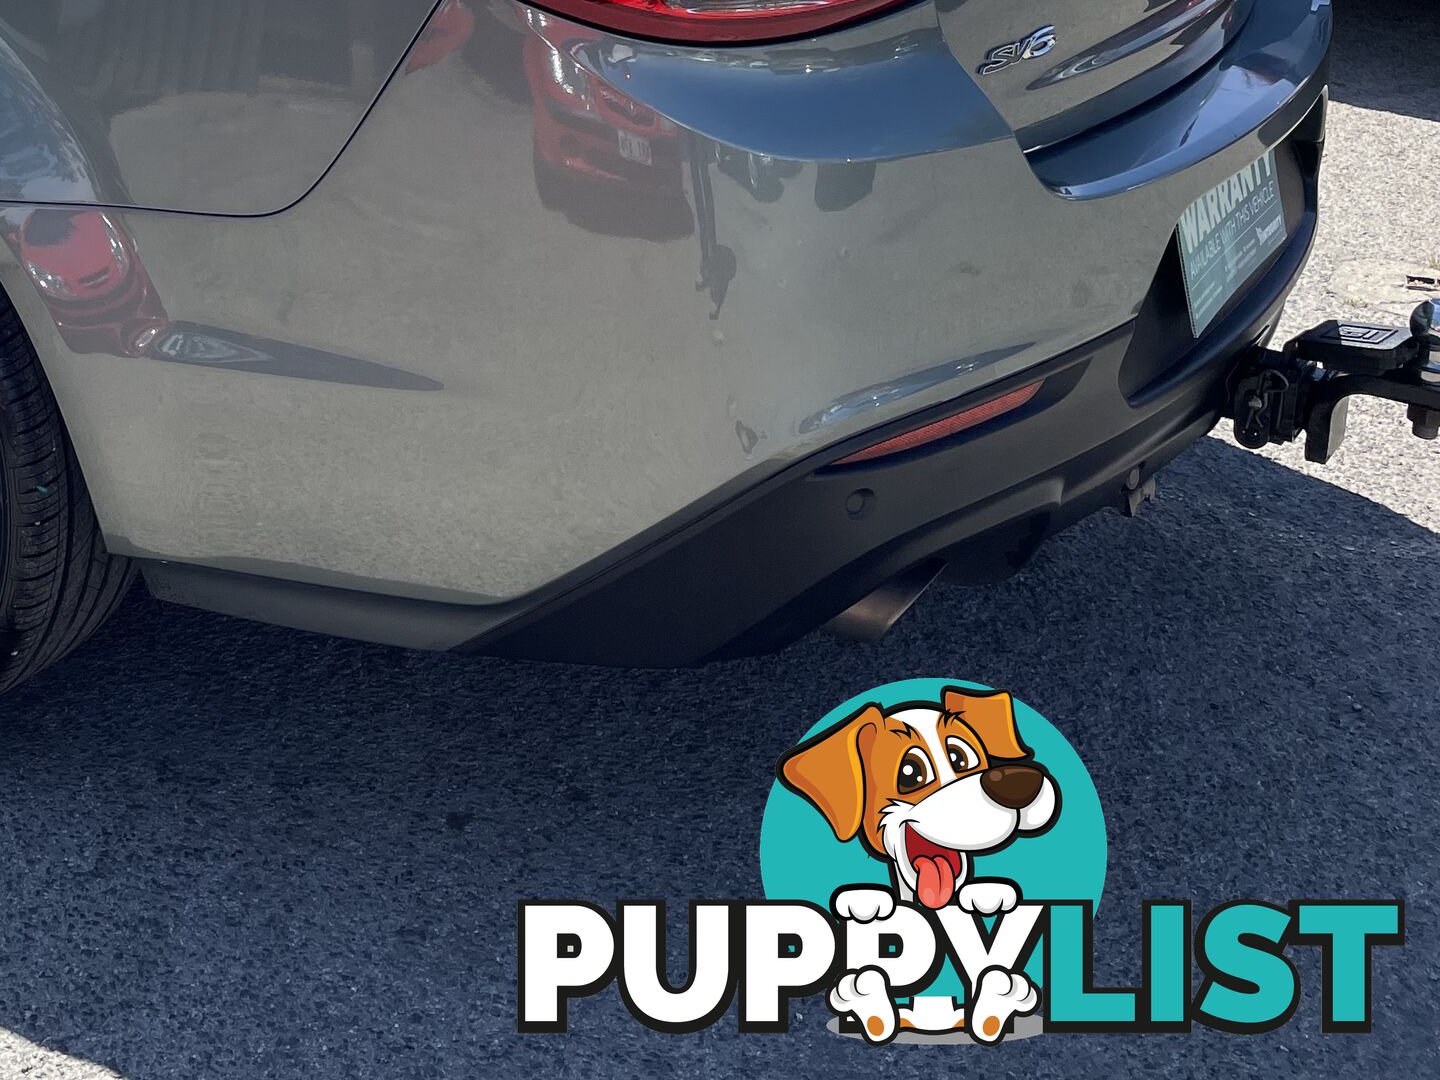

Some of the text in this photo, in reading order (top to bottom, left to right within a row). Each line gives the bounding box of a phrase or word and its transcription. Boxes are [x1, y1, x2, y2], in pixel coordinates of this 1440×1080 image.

[975, 24, 1056, 75] SV6
[1180, 151, 1271, 254] WARRANTY
[1190, 232, 1222, 280] AVAILABLE
[1220, 217, 1239, 247] WITH
[1235, 204, 1251, 230] THIS
[1248, 180, 1275, 216] VEHICLE
